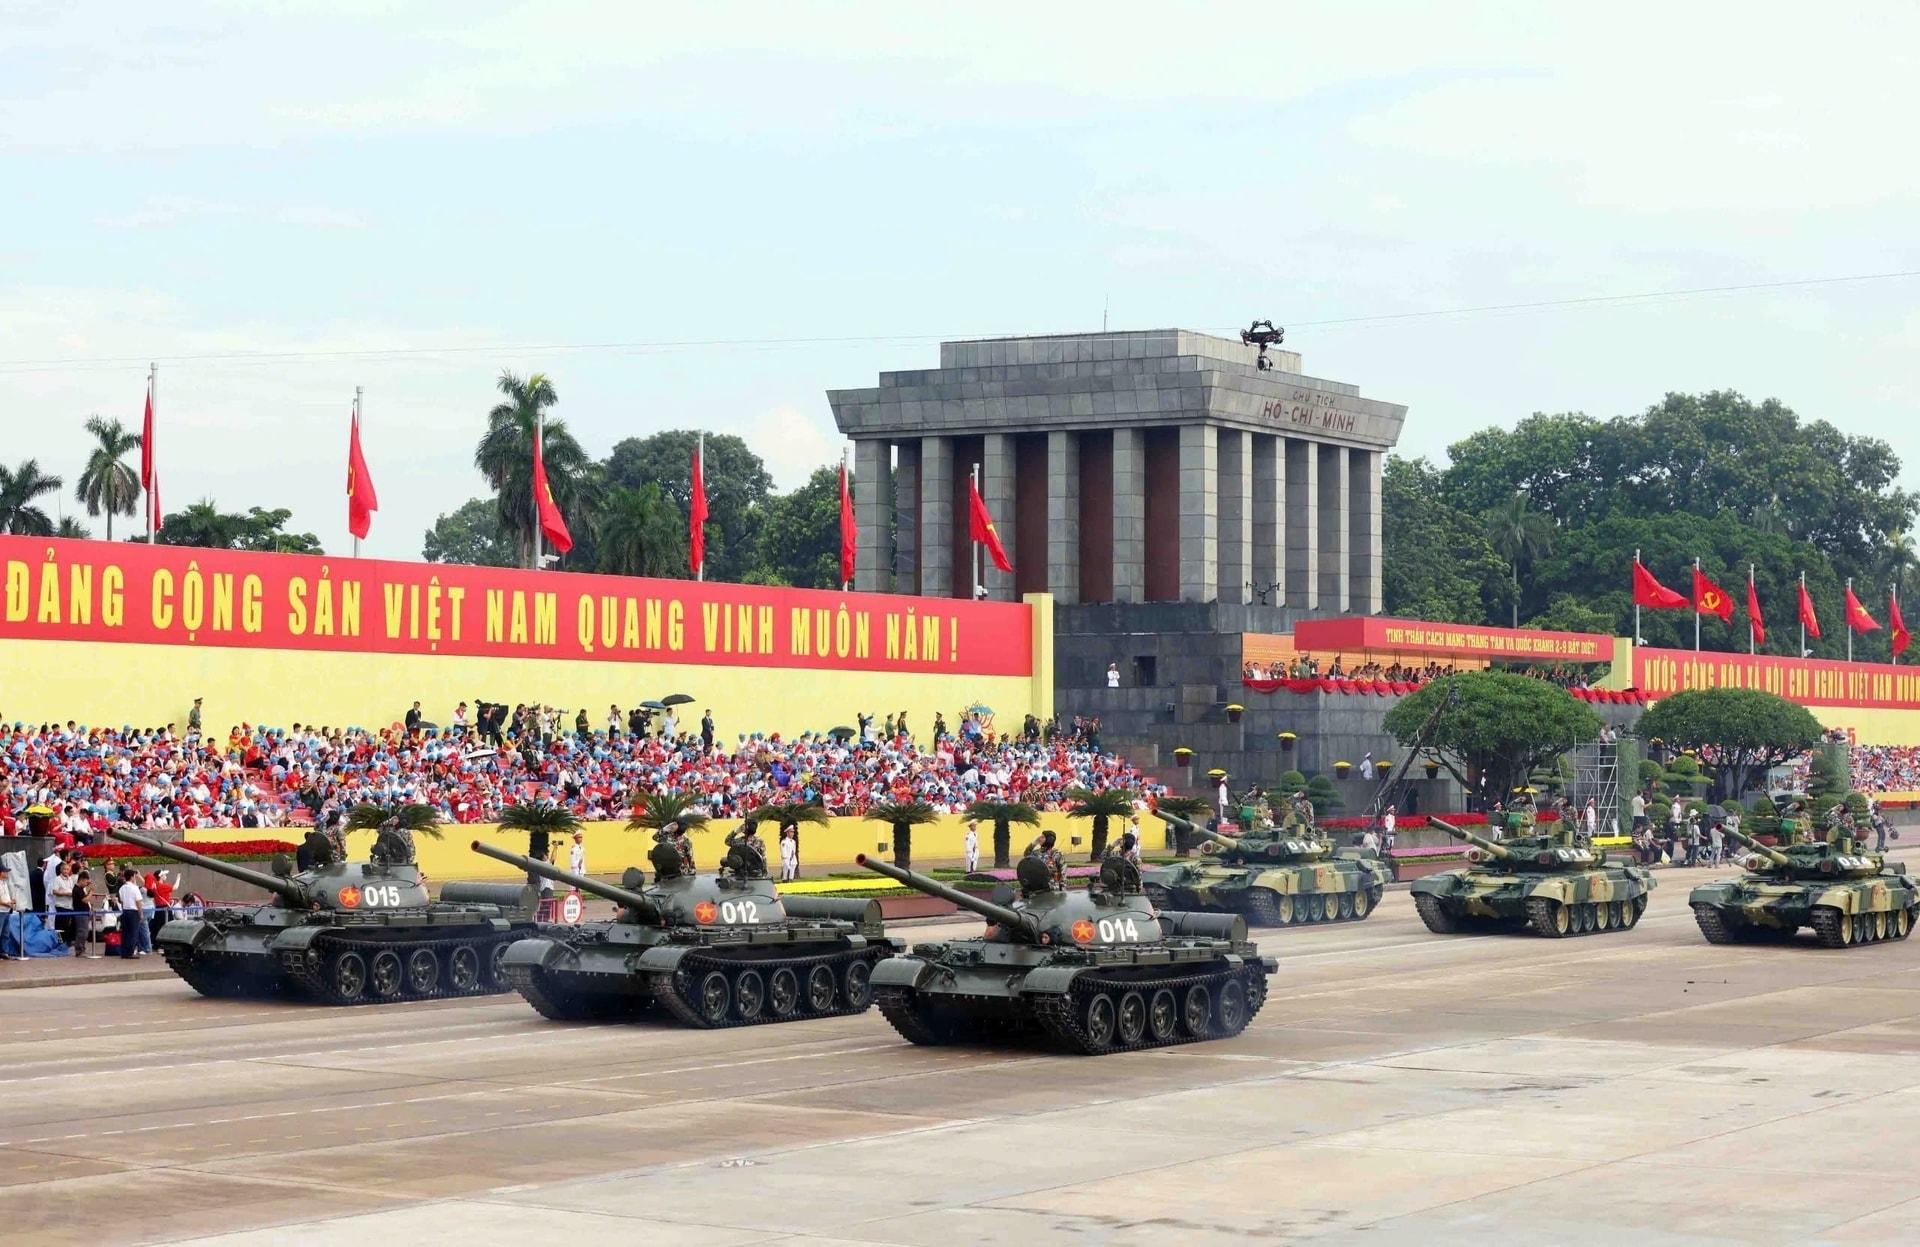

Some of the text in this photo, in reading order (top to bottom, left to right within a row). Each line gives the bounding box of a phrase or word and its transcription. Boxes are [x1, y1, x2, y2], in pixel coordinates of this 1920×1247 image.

[5, 547, 124, 627] ĐẢNG
[151, 560, 263, 642] CỘNG
[288, 565, 361, 637] SẢN
[383, 575, 465, 651] VIỆT
[486, 588, 557, 645] NAM
[577, 593, 684, 653] QUANG
[702, 601, 774, 655] VINH
[791, 602, 870, 659] MUÔN
[1645, 654, 1676, 692] NƯỚC
[1789, 662, 1811, 698] CHỦ
[1814, 667, 1844, 699] NGHĨA
[1848, 667, 1869, 706] VIỆT
[1872, 673, 1892, 701] NAM
[364, 886, 400, 907] 015
[721, 901, 759, 924] 012
[1099, 918, 1138, 943] 014
